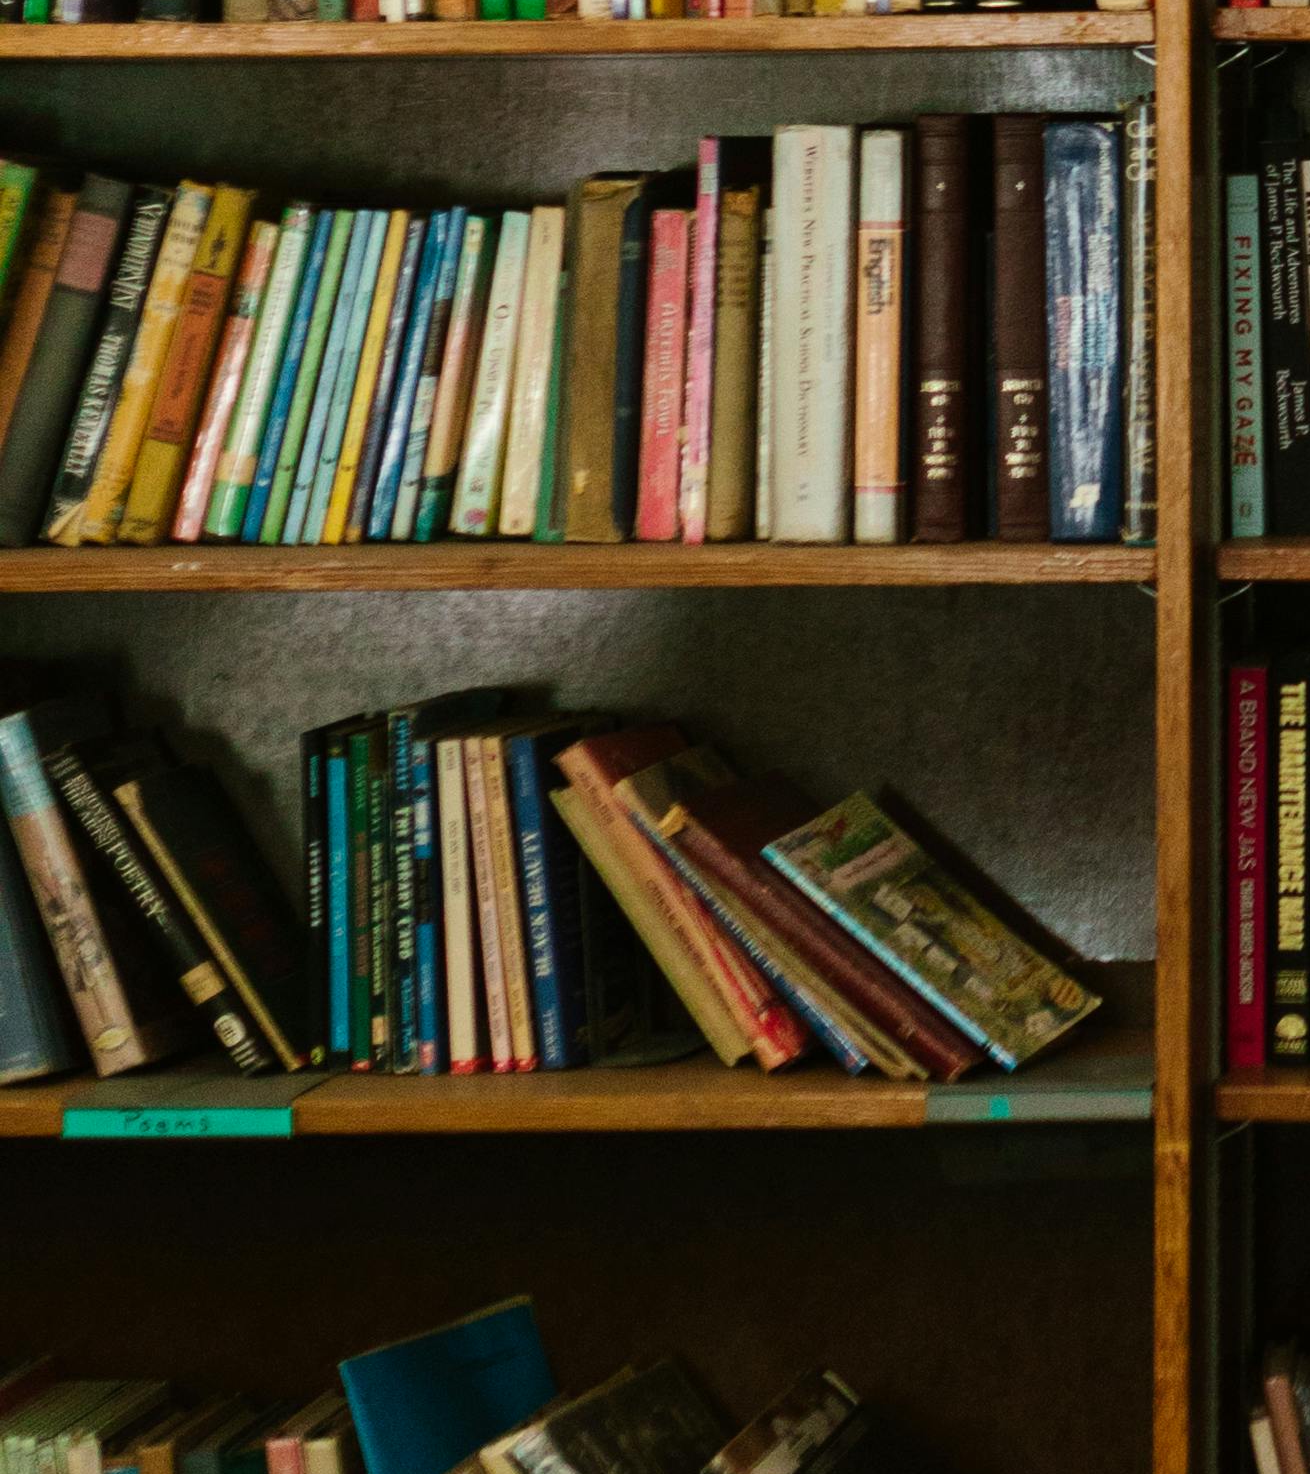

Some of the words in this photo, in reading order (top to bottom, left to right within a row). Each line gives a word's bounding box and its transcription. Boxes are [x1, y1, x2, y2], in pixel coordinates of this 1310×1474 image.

[1233, 234, 1251, 336] FIXING
[1235, 348, 1252, 386] MY
[1233, 398, 1257, 467] GAZE
